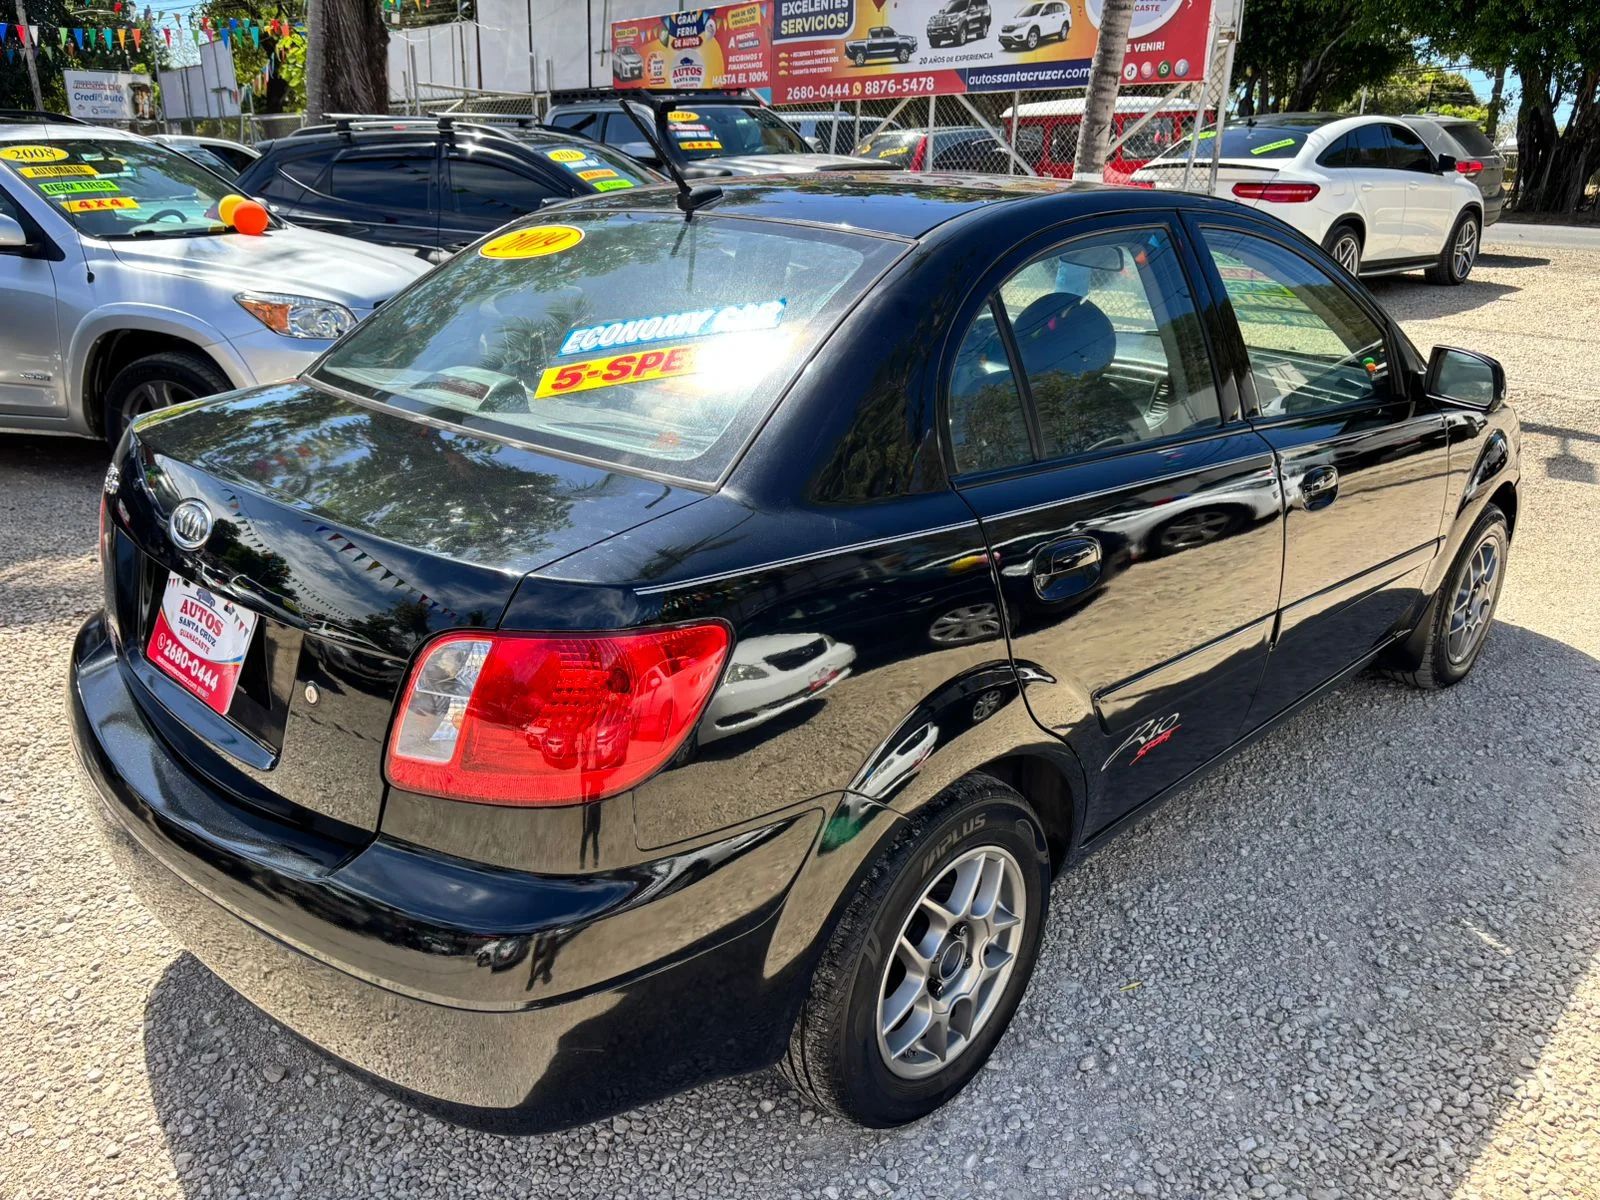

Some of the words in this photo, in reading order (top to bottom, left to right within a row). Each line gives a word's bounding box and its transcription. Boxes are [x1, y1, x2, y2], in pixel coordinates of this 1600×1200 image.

[782, 0, 849, 16] EXCELENTES
[677, 14, 697, 25] GRAN
[781, 12, 849, 35] SERVICIOS!
[676, 26, 698, 37] FERIA
[682, 37, 700, 47] AUTOS
[728, 36, 736, 49] A
[1125, 44, 1131, 53] E
[1134, 41, 1165, 53] VENIR!
[919, 57, 928, 65] 20
[929, 55, 946, 64] AÑOS
[955, 52, 994, 62] EXPERIENCIA
[672, 67, 702, 78] AUTOS
[712, 73, 737, 85] HASTA
[738, 72, 747, 83] EL
[749, 71, 768, 82] 100%
[968, 67, 1091, 85] autossantacruzcr.com
[787, 83, 849, 100] 2680-0444
[865, 76, 934, 95] 8876-5478
[10, 148, 55, 160] 2008
[32, 165, 87, 176] AUTOMATIC
[45, 182, 73, 192] NEW
[560, 309, 714, 354] ECONOMY
[180, 598, 224, 637] AUTOS
[178, 616, 200, 633] SANTA
[199, 628, 217, 647] CRUZ
[179, 629, 210, 655] GUANACASTE
[163, 639, 219, 692] 2680-0444
